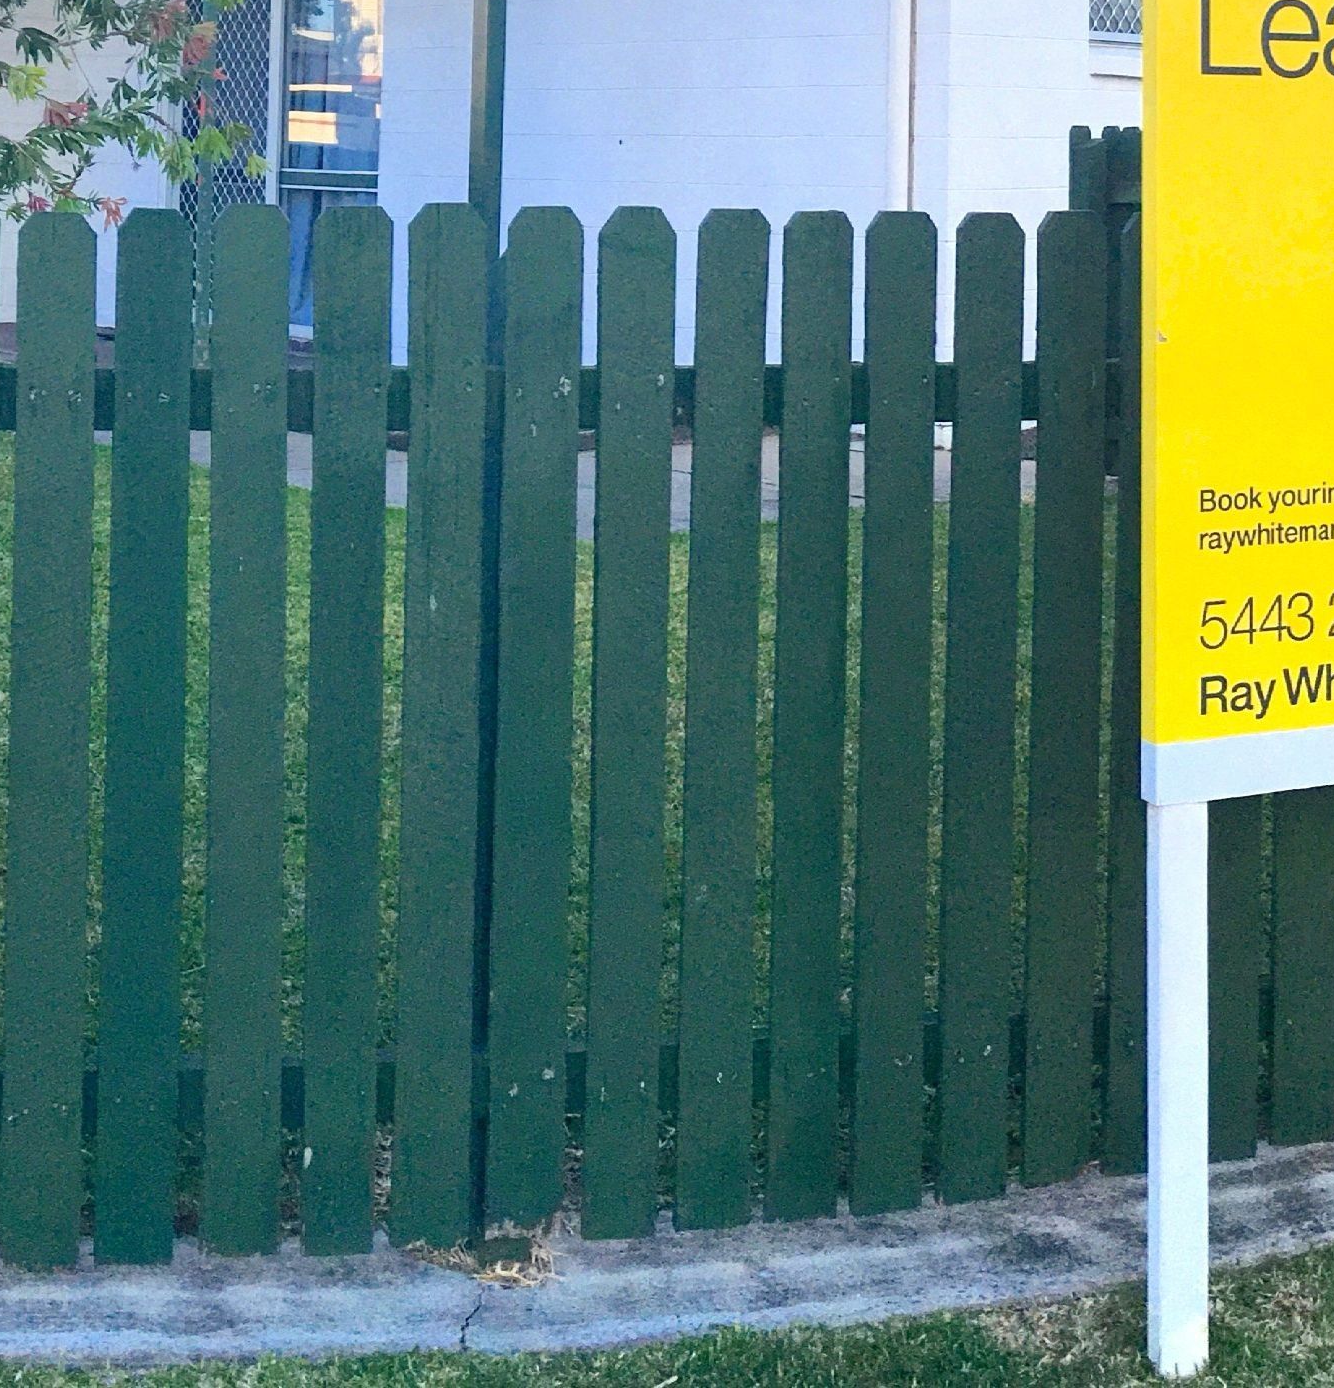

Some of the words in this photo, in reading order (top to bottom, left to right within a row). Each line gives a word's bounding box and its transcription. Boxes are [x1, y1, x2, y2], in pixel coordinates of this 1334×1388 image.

[1200, 486, 1263, 513] Book
[1200, 592, 1315, 650] 5443
[1200, 674, 1276, 720] Ray
